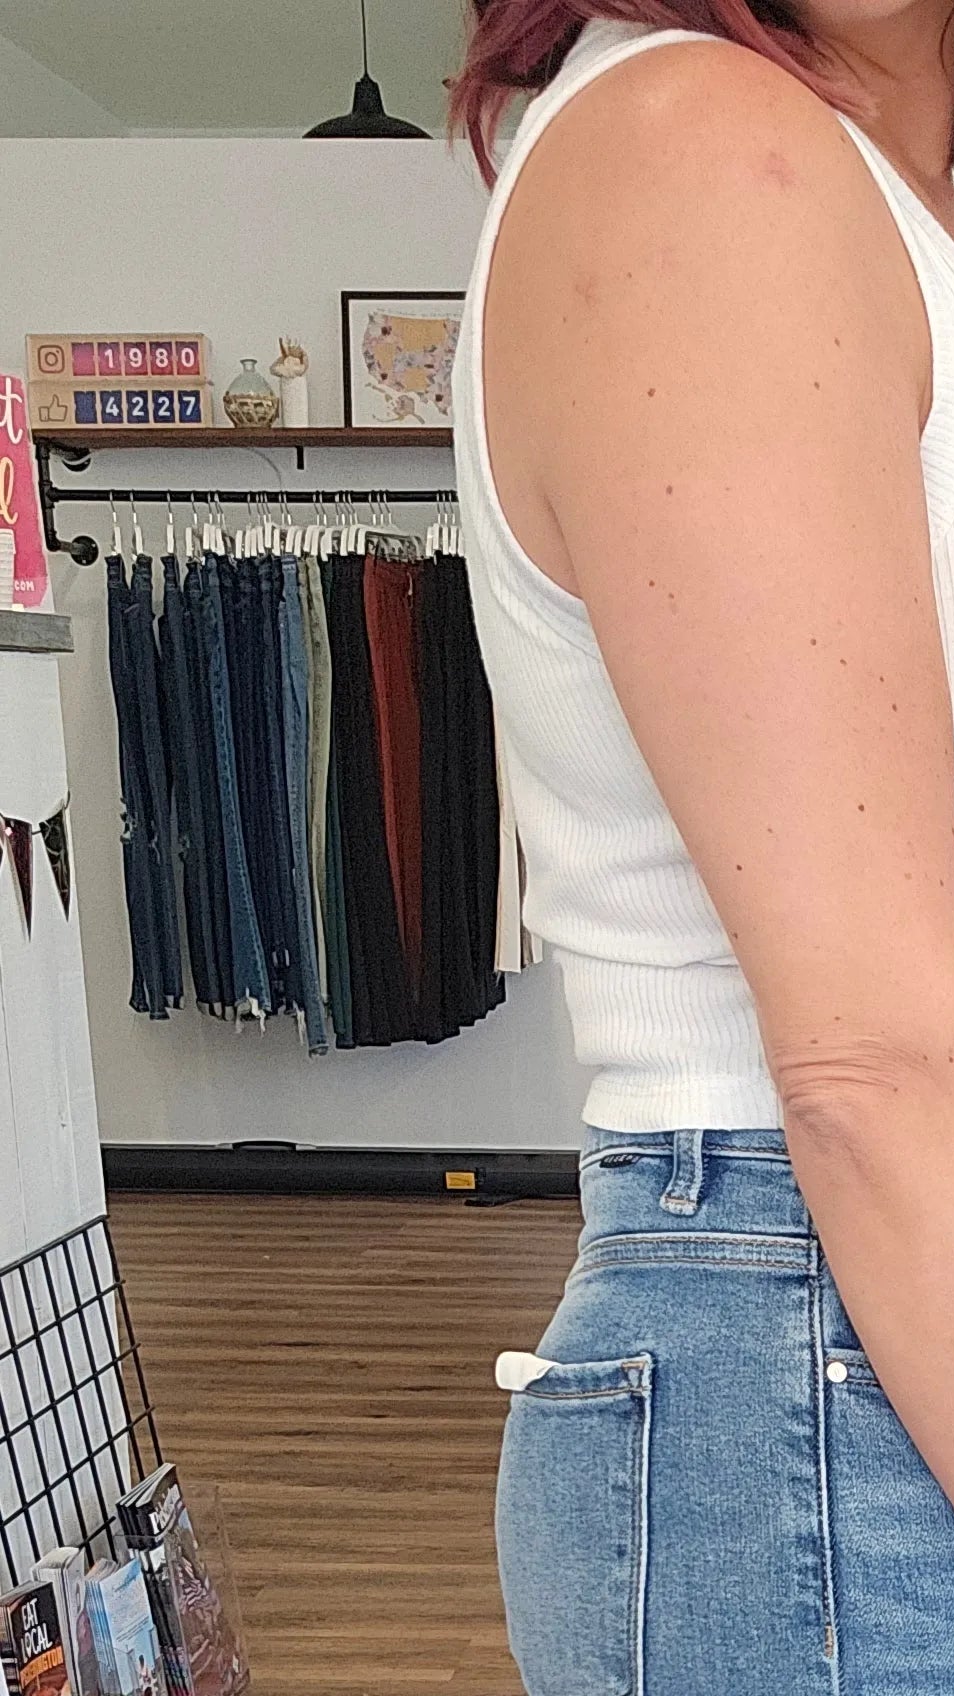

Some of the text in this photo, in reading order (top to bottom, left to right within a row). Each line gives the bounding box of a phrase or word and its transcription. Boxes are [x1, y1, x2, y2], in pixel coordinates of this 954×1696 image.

[104, 347, 195, 369] 1980
[105, 396, 196, 417] 4227
[21, 1597, 39, 1631] EAT
